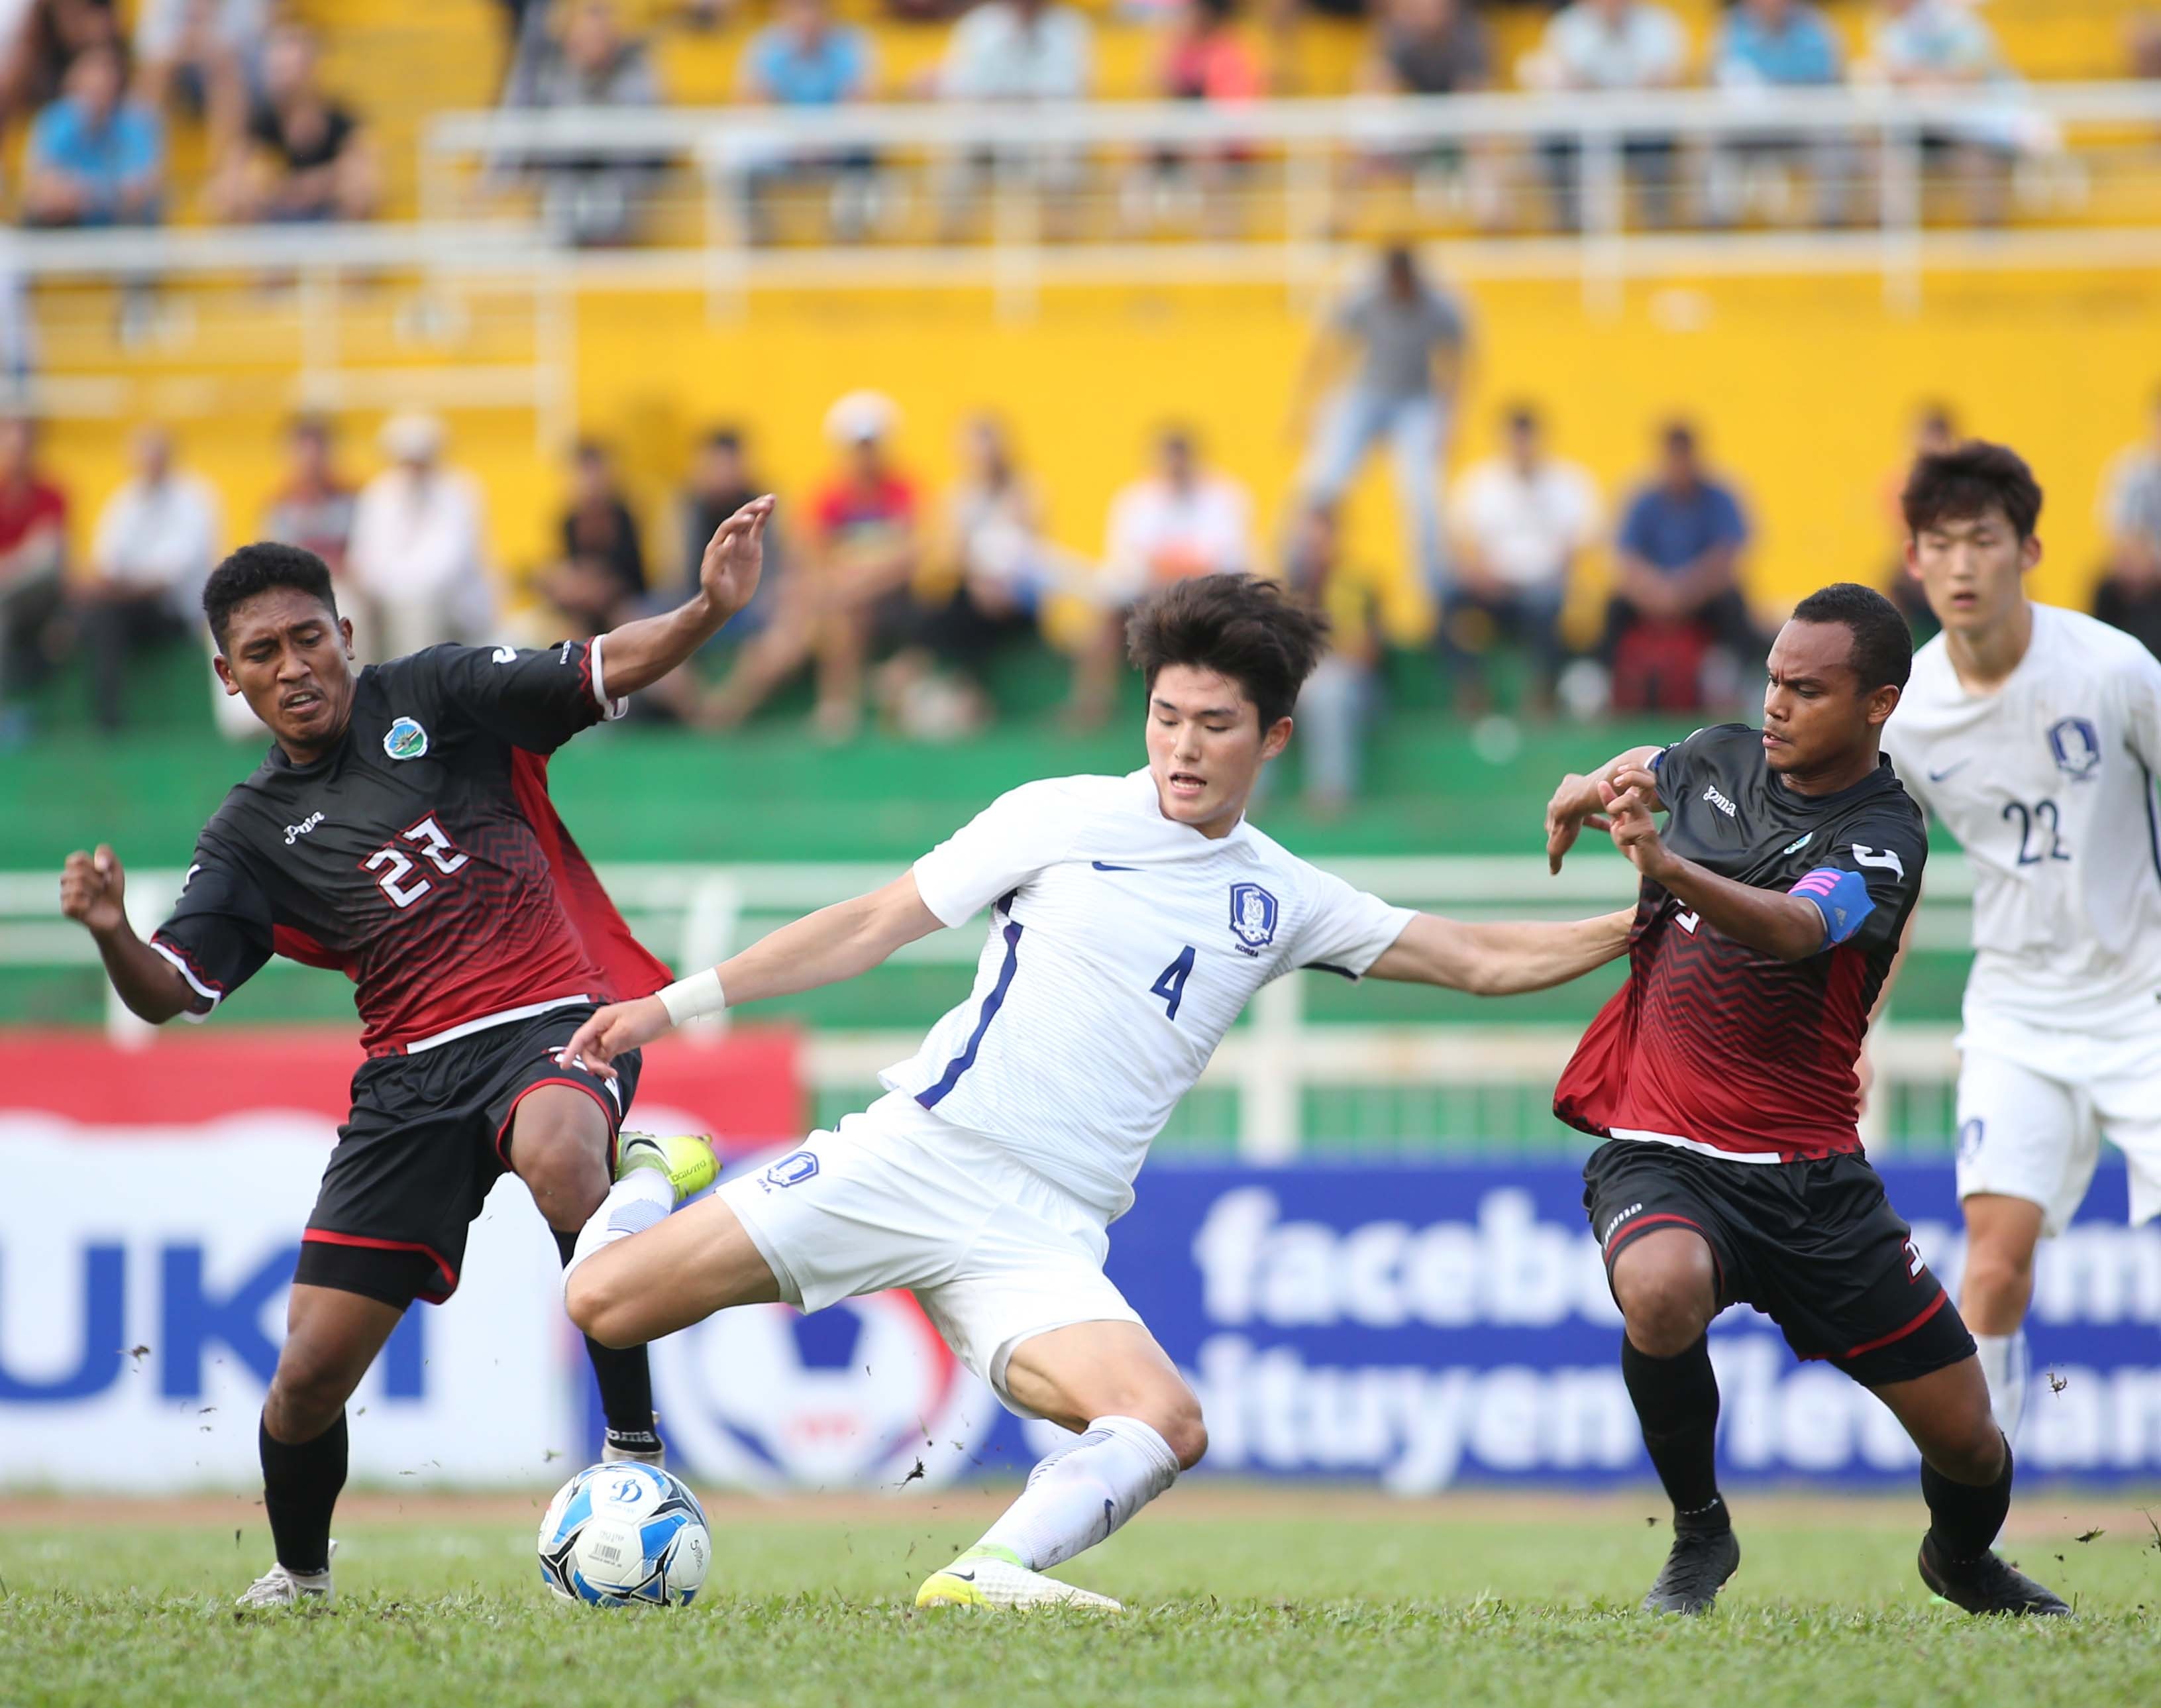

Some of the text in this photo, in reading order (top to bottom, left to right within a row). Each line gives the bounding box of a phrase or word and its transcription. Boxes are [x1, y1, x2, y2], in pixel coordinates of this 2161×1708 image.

[1703, 784, 1736, 818] Joma
[2002, 797, 2071, 866] 22
[1149, 944, 1196, 1022] 4
